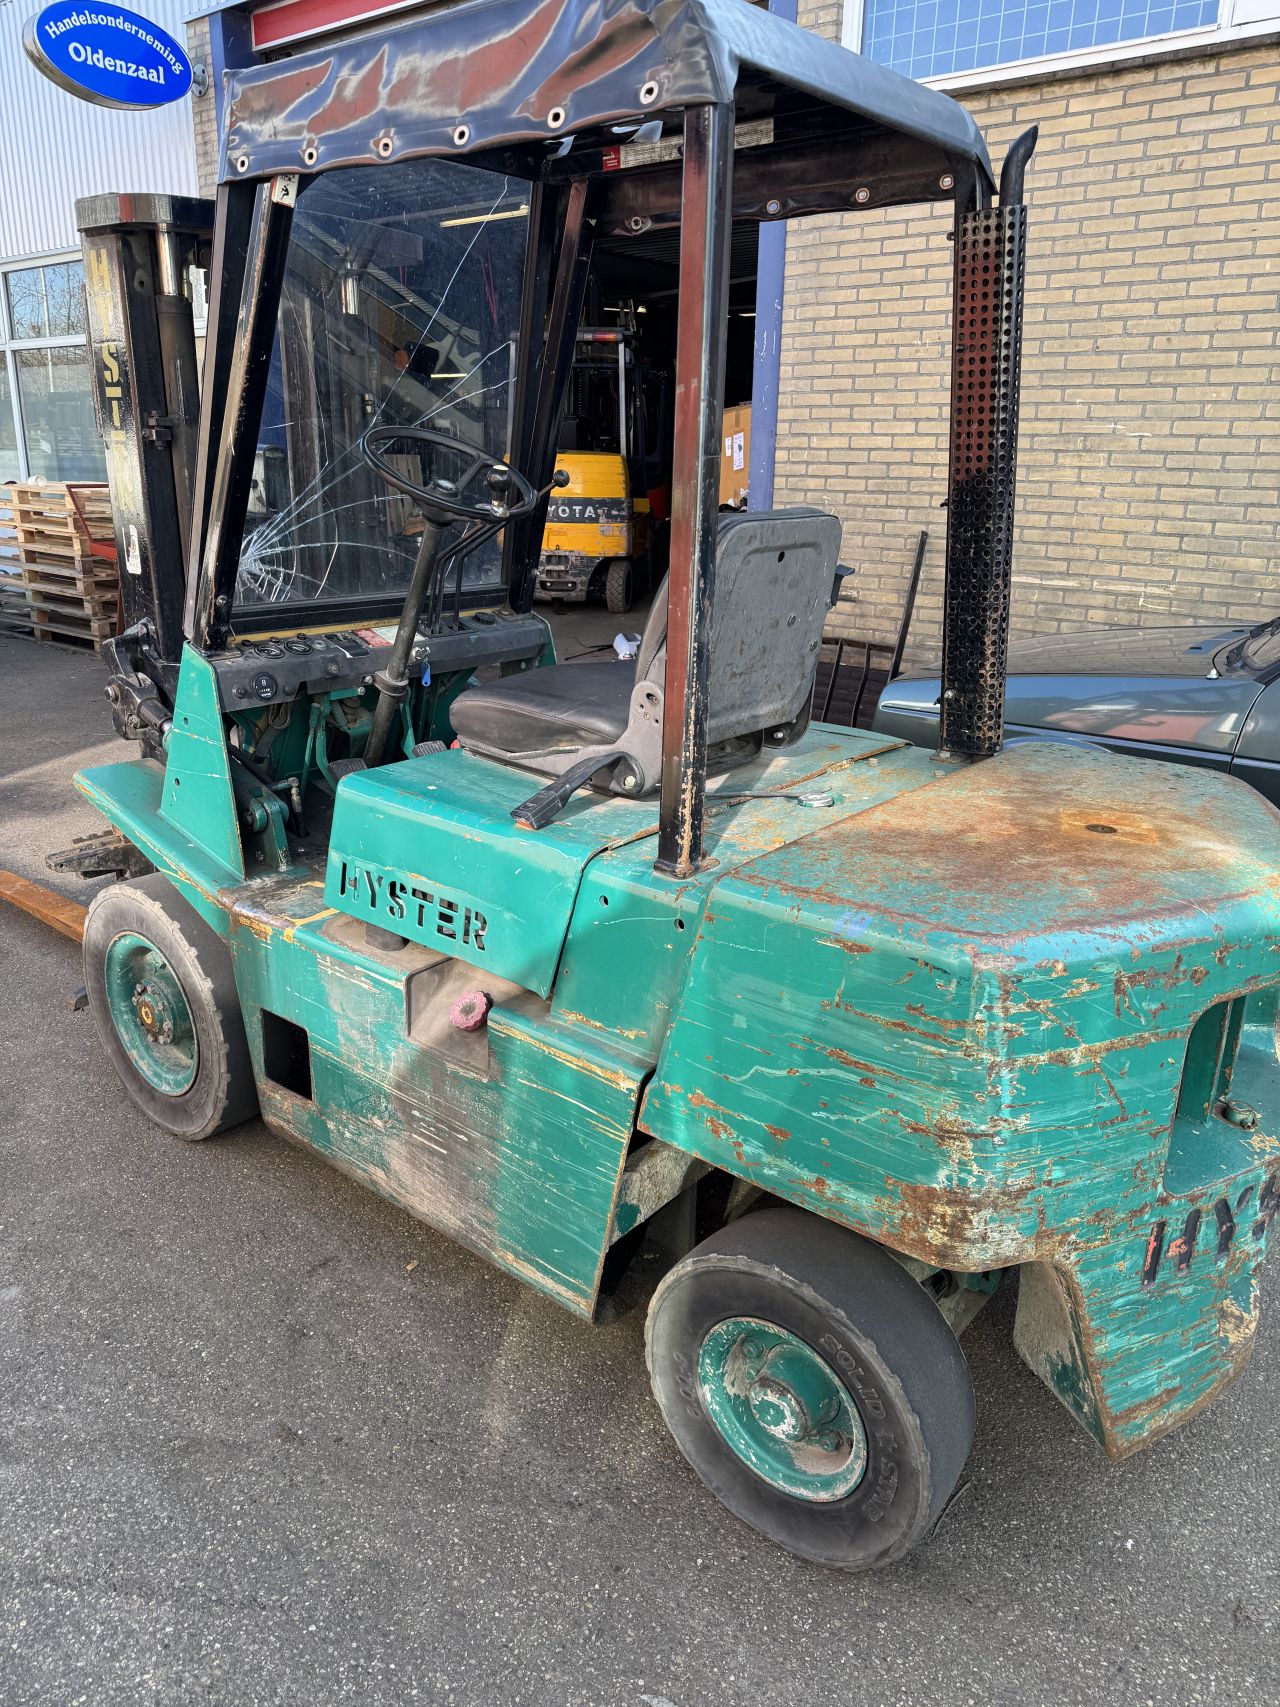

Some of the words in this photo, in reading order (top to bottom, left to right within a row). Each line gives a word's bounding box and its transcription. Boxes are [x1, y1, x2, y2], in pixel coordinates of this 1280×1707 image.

[45, 10, 184, 75] Handelsonderneming
[68, 41, 166, 85] Oldenzaal
[339, 861, 487, 952] HYSTER
[818, 1333, 887, 1420] SOLID
[861, 1456, 900, 1523] STAR
